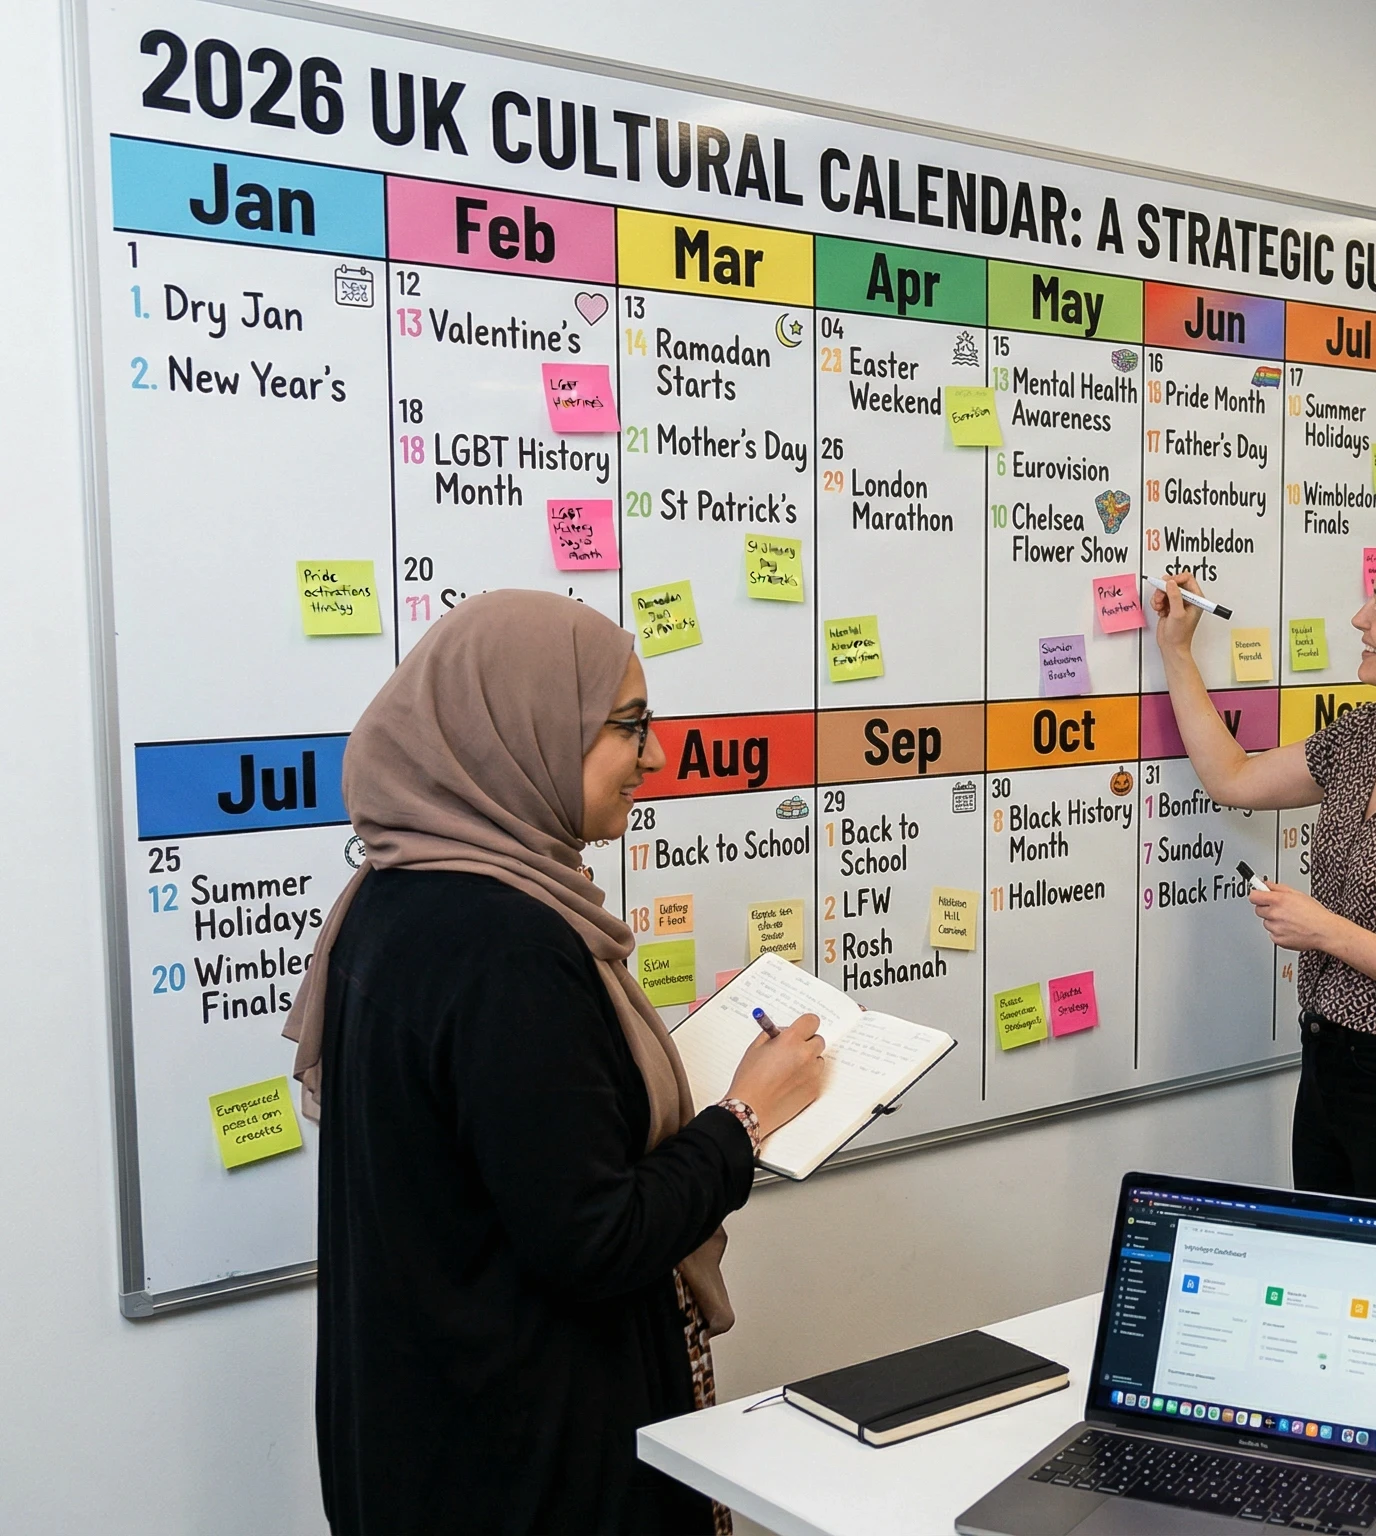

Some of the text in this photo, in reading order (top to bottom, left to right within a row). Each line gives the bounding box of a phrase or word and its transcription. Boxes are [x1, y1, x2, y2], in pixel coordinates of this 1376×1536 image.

[140, 29, 345, 135] 2026
[370, 67, 469, 156] UK
[491, 90, 804, 206] CULTURAL
[820, 147, 1082, 248] CALENDAR:
[1097, 197, 1125, 255] A
[1137, 202, 1335, 284] STRATEGIC
[189, 163, 316, 237] Jan
[455, 196, 556, 263] Feb
[127, 242, 138, 268] 1
[674, 226, 764, 288] Mar
[396, 271, 421, 296] 12
[866, 252, 941, 315] Apr
[131, 285, 150, 318] 1.
[164, 284, 227, 338] Dry
[241, 291, 303, 331] Jan
[624, 296, 645, 319] 13
[1032, 273, 1104, 338] May
[1184, 297, 1246, 344] Jun
[396, 308, 581, 354] 13 Valentine's
[821, 317, 844, 339] 04
[1326, 316, 1372, 359] Jul
[625, 327, 771, 368] 14 Ramadan
[993, 335, 1010, 356] 15
[1149, 352, 1163, 373] 16
[131, 355, 347, 402] 2. New Year's
[850, 346, 919, 380] Easter
[1290, 368, 1303, 387] 17
[656, 364, 736, 400] Starts
[849, 380, 942, 416] Weekend
[992, 366, 1138, 404] 13 Mental Health
[1147, 380, 1266, 414] 18 Pride Month
[399, 399, 424, 424] 18
[1012, 399, 1112, 432] Awareness
[1305, 393, 1366, 422] Summer
[626, 423, 807, 473] 21 Mother's Day
[821, 437, 844, 460] 26
[1165, 429, 1232, 458] Father's
[1237, 433, 1268, 469] Day
[1305, 421, 1370, 459] Holidays
[400, 433, 610, 484] 18 LGBT History
[996, 450, 1110, 482] 6 Eurovision
[435, 472, 523, 506] Month
[823, 468, 928, 499] 29 London
[1146, 478, 1266, 517] 18 Glastonbury
[626, 488, 798, 524] 20 St Patrick's
[852, 501, 953, 532] Marathon
[991, 502, 1085, 532] 10 Chelsea
[1305, 510, 1349, 534] Finals
[1013, 535, 1129, 563] Flower Show
[1145, 526, 1254, 553] 13 Wimbledon
[404, 557, 434, 581] 20
[864, 718, 942, 775] Sep
[1033, 709, 1096, 755] Oct
[677, 729, 769, 788] Aug
[1145, 765, 1160, 784] 31
[217, 751, 317, 815] Jul
[992, 778, 1011, 798] 30
[824, 790, 845, 813] 29
[1010, 800, 1061, 831] Black
[1068, 797, 1133, 829] History
[1145, 795, 1154, 819] 1
[631, 808, 656, 831] 28
[825, 813, 919, 847] 1 Back to
[629, 825, 810, 871] 17 Back to School
[1010, 831, 1069, 863] Month
[1144, 832, 1224, 866] 7 Sunday
[1283, 827, 1298, 849] 19
[148, 846, 181, 874] 25
[841, 844, 907, 876] School
[148, 874, 312, 913] 12 Summer
[824, 886, 891, 921] 2 LFW
[990, 886, 1004, 911] 11
[1009, 879, 1105, 910] Halloween
[1143, 888, 1153, 910] 9
[1158, 877, 1207, 908] Black
[194, 902, 323, 941] Holidays
[824, 928, 893, 964] 3 Rosh
[152, 963, 186, 994] 20
[844, 950, 947, 992] Hashanah
[202, 983, 293, 1024] Finals
